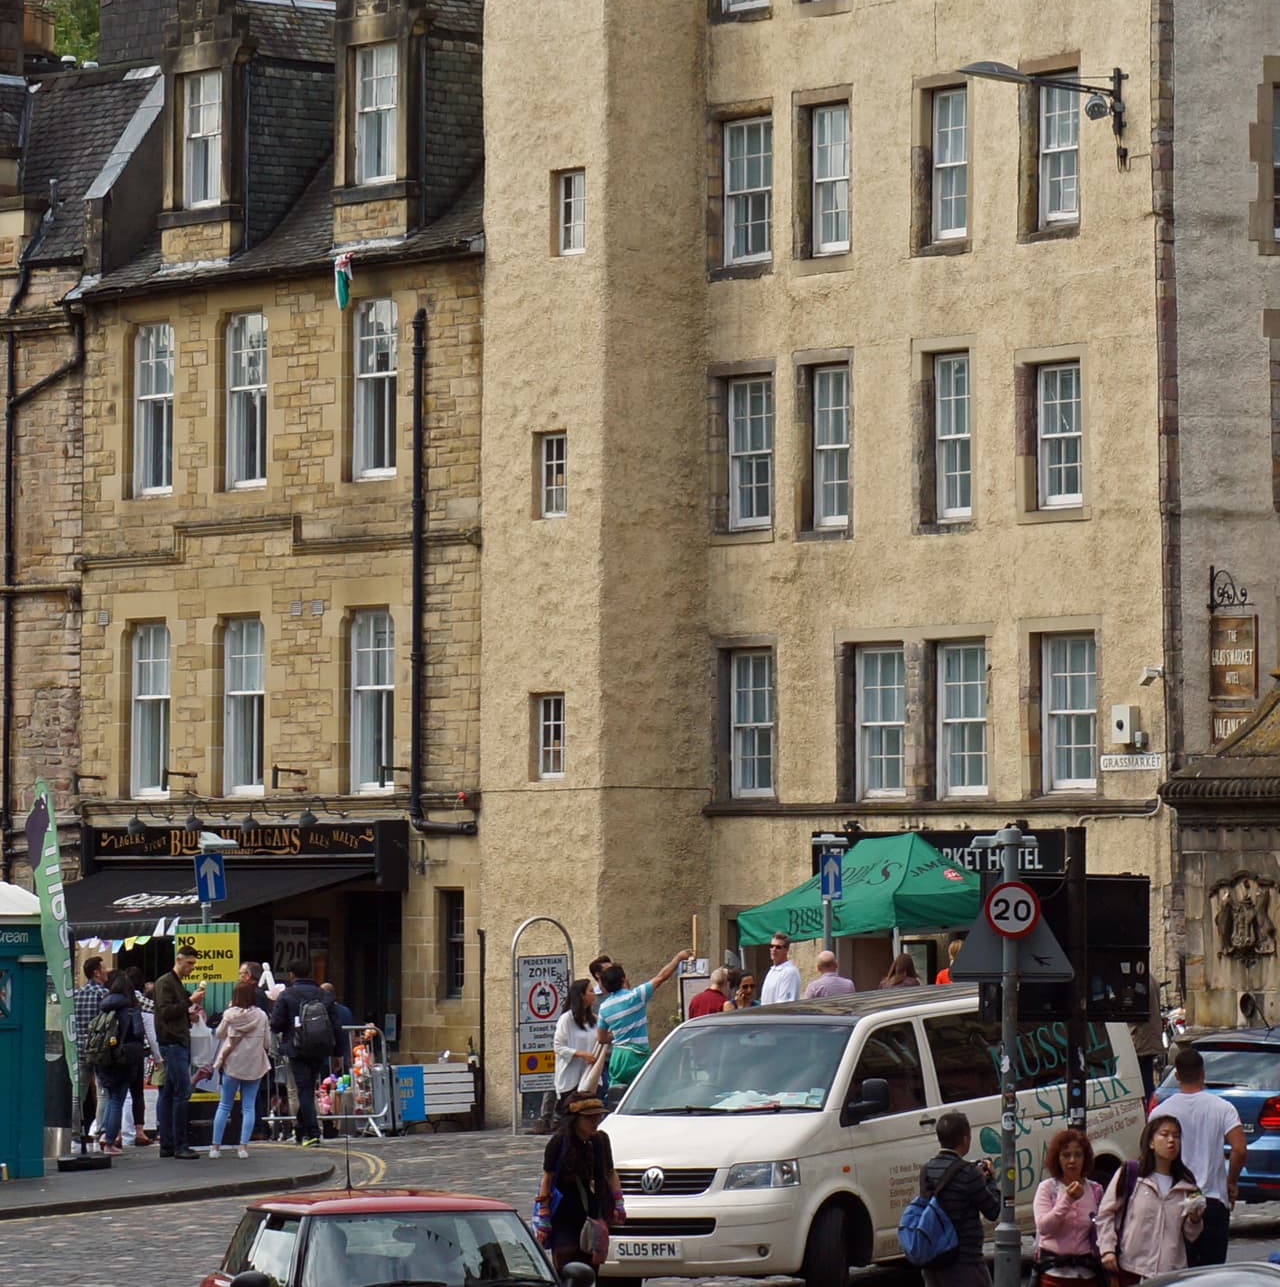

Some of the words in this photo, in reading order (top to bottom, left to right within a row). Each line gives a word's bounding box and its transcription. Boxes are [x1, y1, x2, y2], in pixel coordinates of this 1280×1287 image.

[1212, 649, 1254, 667] GRASSMARKET
[1103, 756, 1161, 769] GRASSMARKET
[332, 829, 359, 849] MALTS
[994, 898, 1032, 922] 20
[177, 936, 196, 947] NO
[523, 958, 563, 966] PEDESTRIAN
[202, 972, 222, 983] 9pm
[528, 967, 557, 978] ZONE
[618, 1243, 648, 1257] SL05
[651, 1243, 676, 1257] RFN
